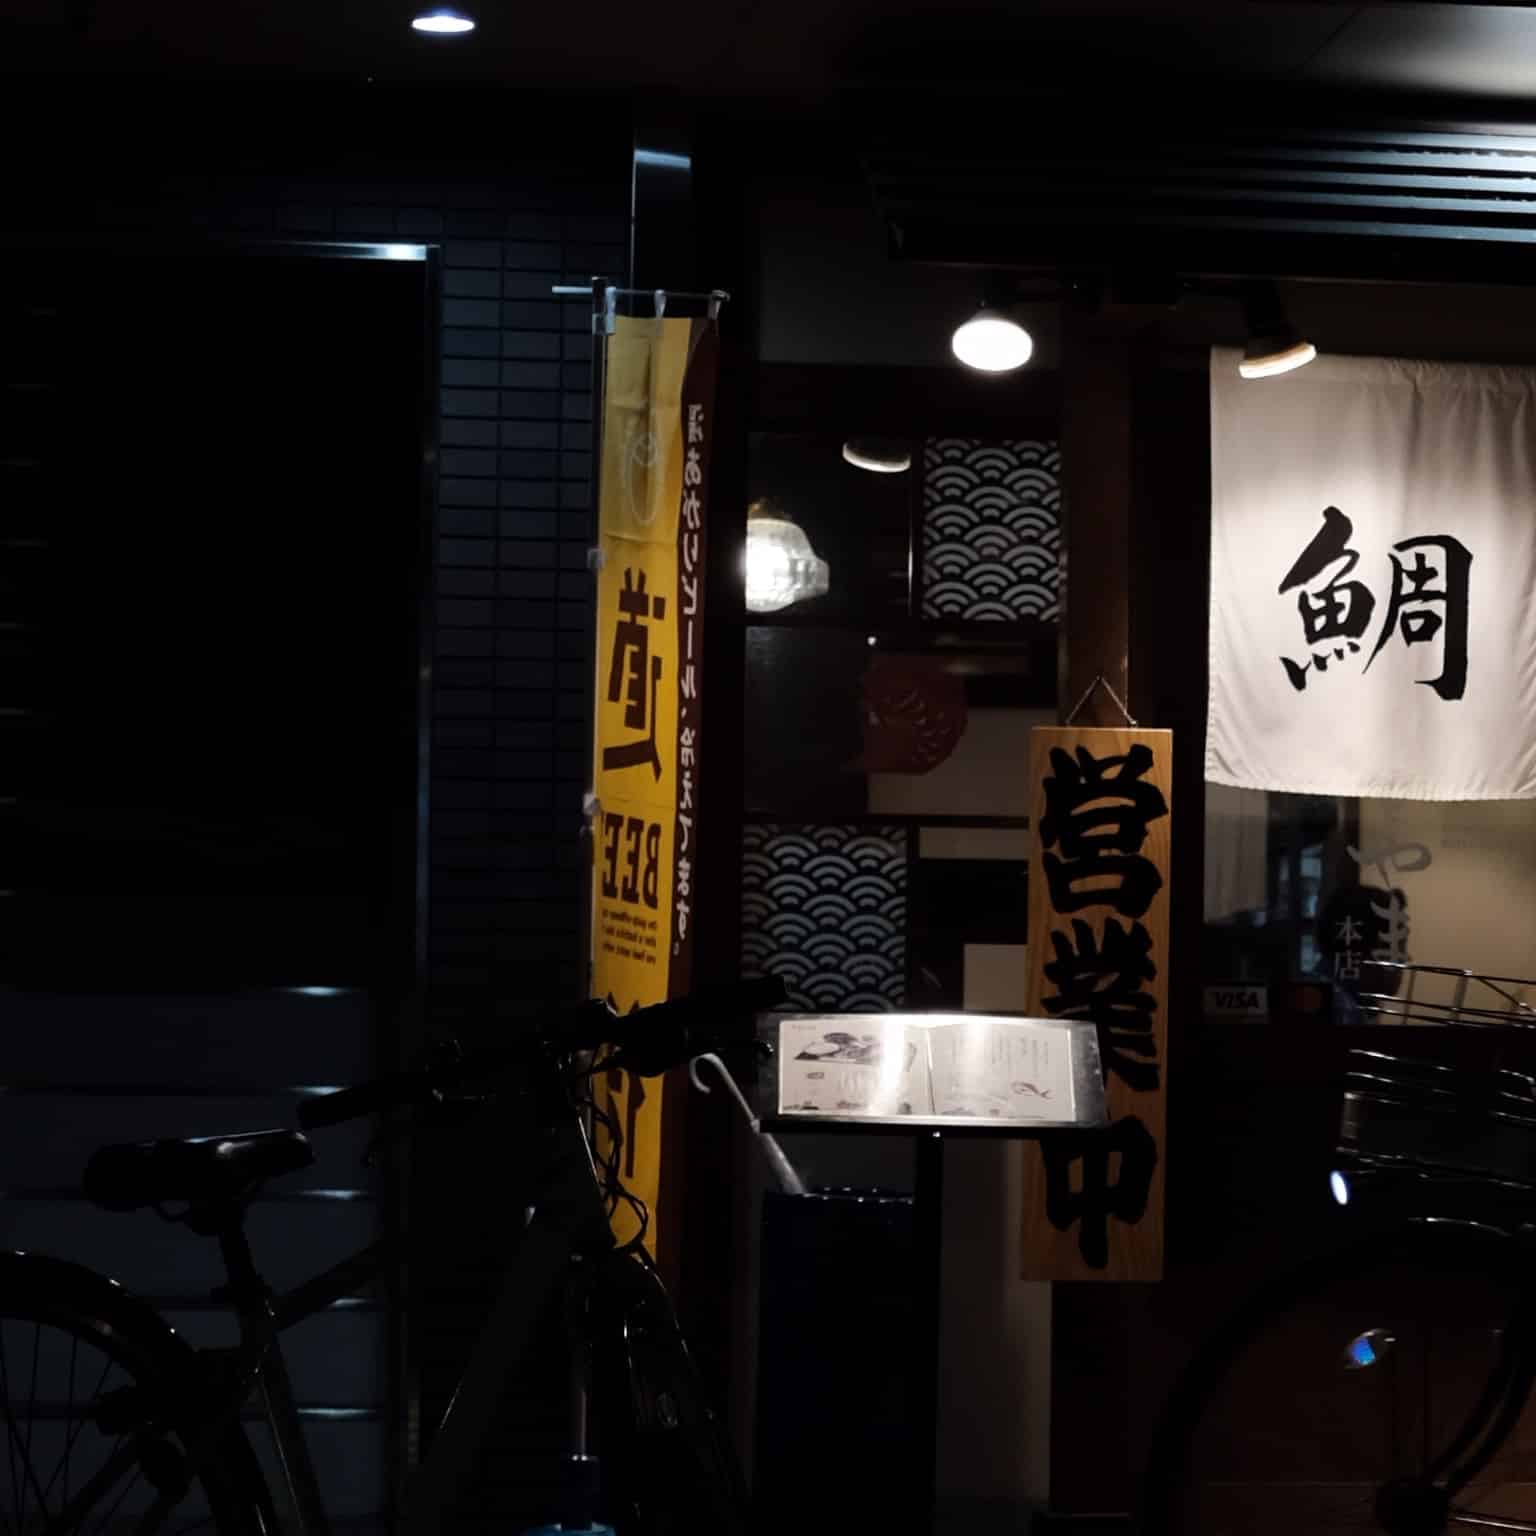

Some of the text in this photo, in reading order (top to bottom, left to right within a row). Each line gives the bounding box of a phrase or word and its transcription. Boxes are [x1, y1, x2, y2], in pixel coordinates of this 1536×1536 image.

[1333, 912, 1367, 982] 本店
[1040, 743, 1169, 1268] 営業中
[1215, 992, 1260, 1009] VISA
